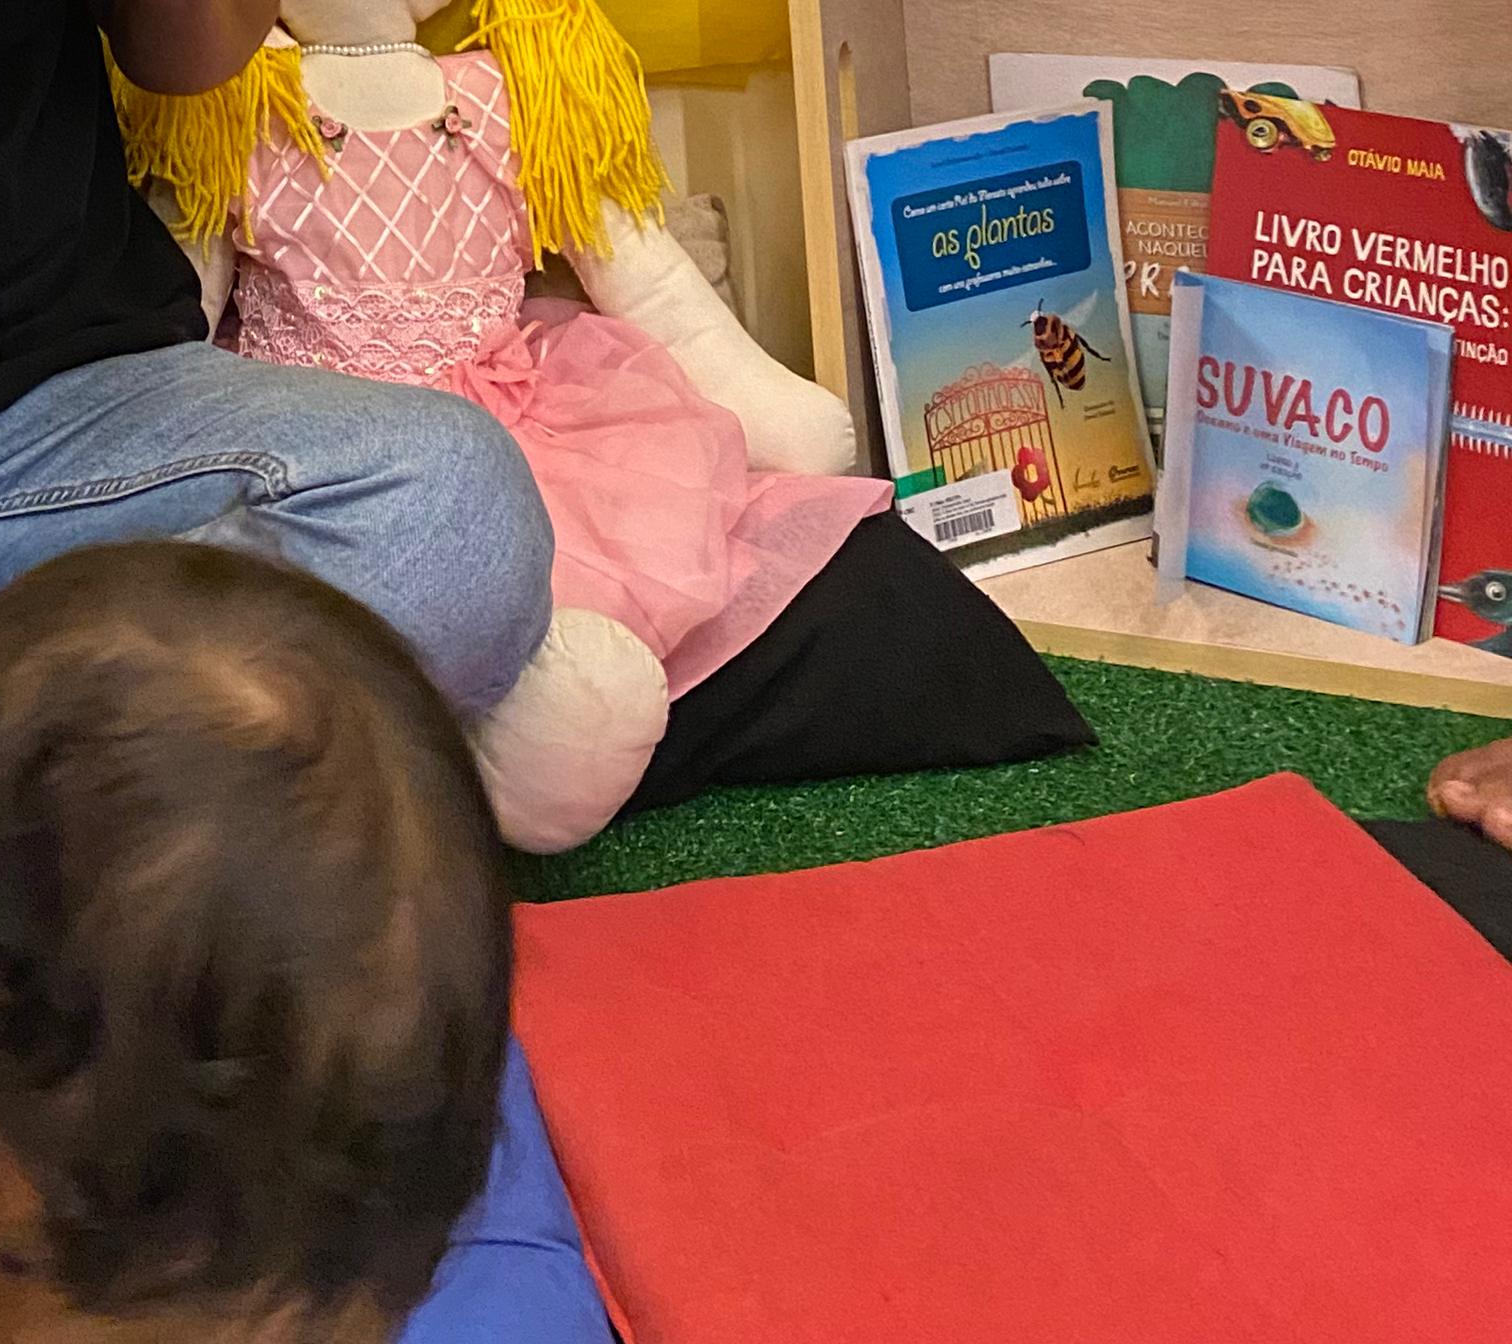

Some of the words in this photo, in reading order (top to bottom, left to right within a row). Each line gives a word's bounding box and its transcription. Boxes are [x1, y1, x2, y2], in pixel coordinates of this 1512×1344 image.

[1347, 148, 1401, 174] OTÁVIO
[1406, 158, 1446, 181] MAIA
[932, 229, 960, 258] as
[964, 203, 1055, 270] plantas
[1126, 220, 1209, 239] ACONTEC
[1138, 240, 1208, 258] NAQUEL
[1254, 211, 1342, 255] LIVRO
[1351, 228, 1509, 290] VERMELHO
[1251, 249, 1332, 295] PARA
[1343, 268, 1510, 329] CRIANÇAS:
[1196, 355, 1391, 453] SUVACO
[1284, 433, 1327, 457] Viagem
[1330, 449, 1345, 461] no
[1350, 450, 1389, 473] Tempo
